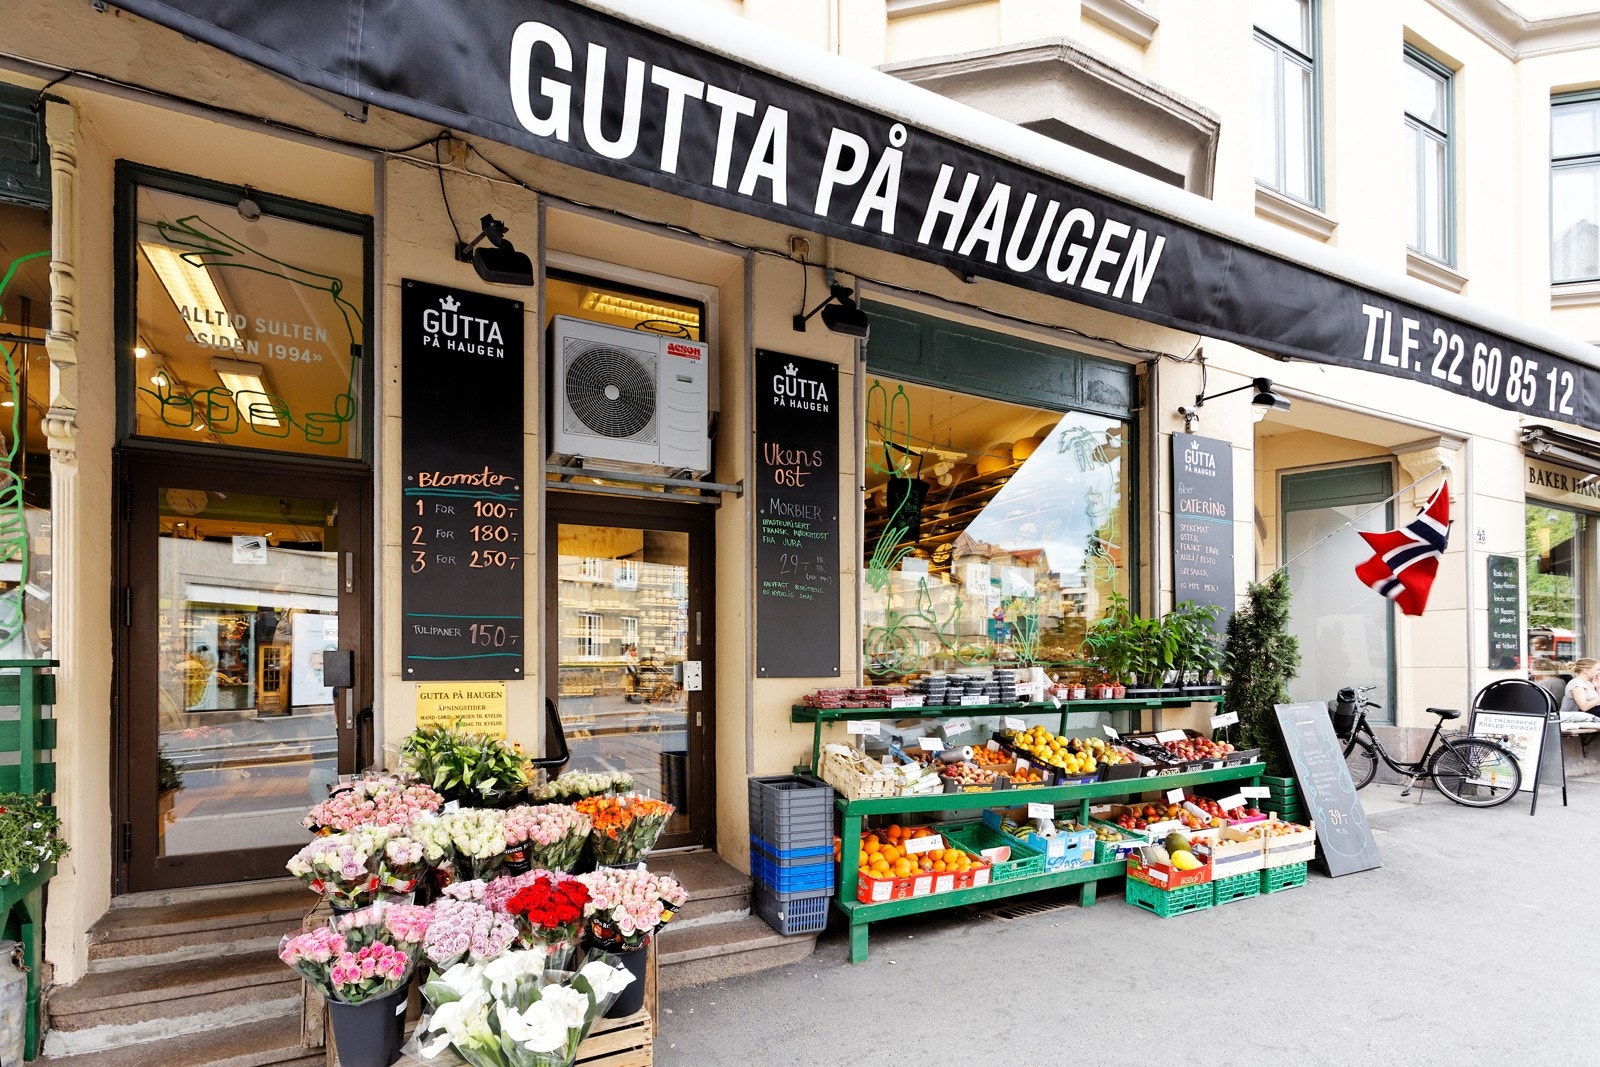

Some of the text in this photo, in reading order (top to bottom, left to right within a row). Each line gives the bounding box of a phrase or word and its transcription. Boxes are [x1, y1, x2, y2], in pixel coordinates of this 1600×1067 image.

[510, 21, 1166, 304] GUTTA PÅ HAUGEN
[179, 304, 327, 343] ALLTID SULTEN
[423, 308, 504, 346] GUTTA
[184, 332, 323, 364] «SIDEN 1994»
[423, 333, 504, 359] PÅ HAUGEN
[1362, 303, 1574, 416] TLF. 22 60 85 12
[773, 374, 828, 401] GUTTA
[773, 395, 829, 413] PÅ HAUGEN
[764, 443, 822, 467] Ukens
[1185, 449, 1216, 469] GUTTA
[419, 465, 515, 488] Blomster
[1185, 464, 1216, 477] PÅ HAUGEN
[1529, 466, 1569, 492] BAKER
[416, 499, 424, 516] 1
[435, 504, 455, 515] FOR
[770, 498, 822, 521] MORBIER
[411, 525, 426, 545] 2
[762, 527, 789, 535] FRANSK
[762, 536, 802, 548] FRA JURA
[410, 550, 426, 574] 3
[436, 554, 456, 565] FOR
[420, 690, 503, 700] GUTTA PÅ HAUGEN
[437, 704, 487, 712] ÅPNINGSTIDER
